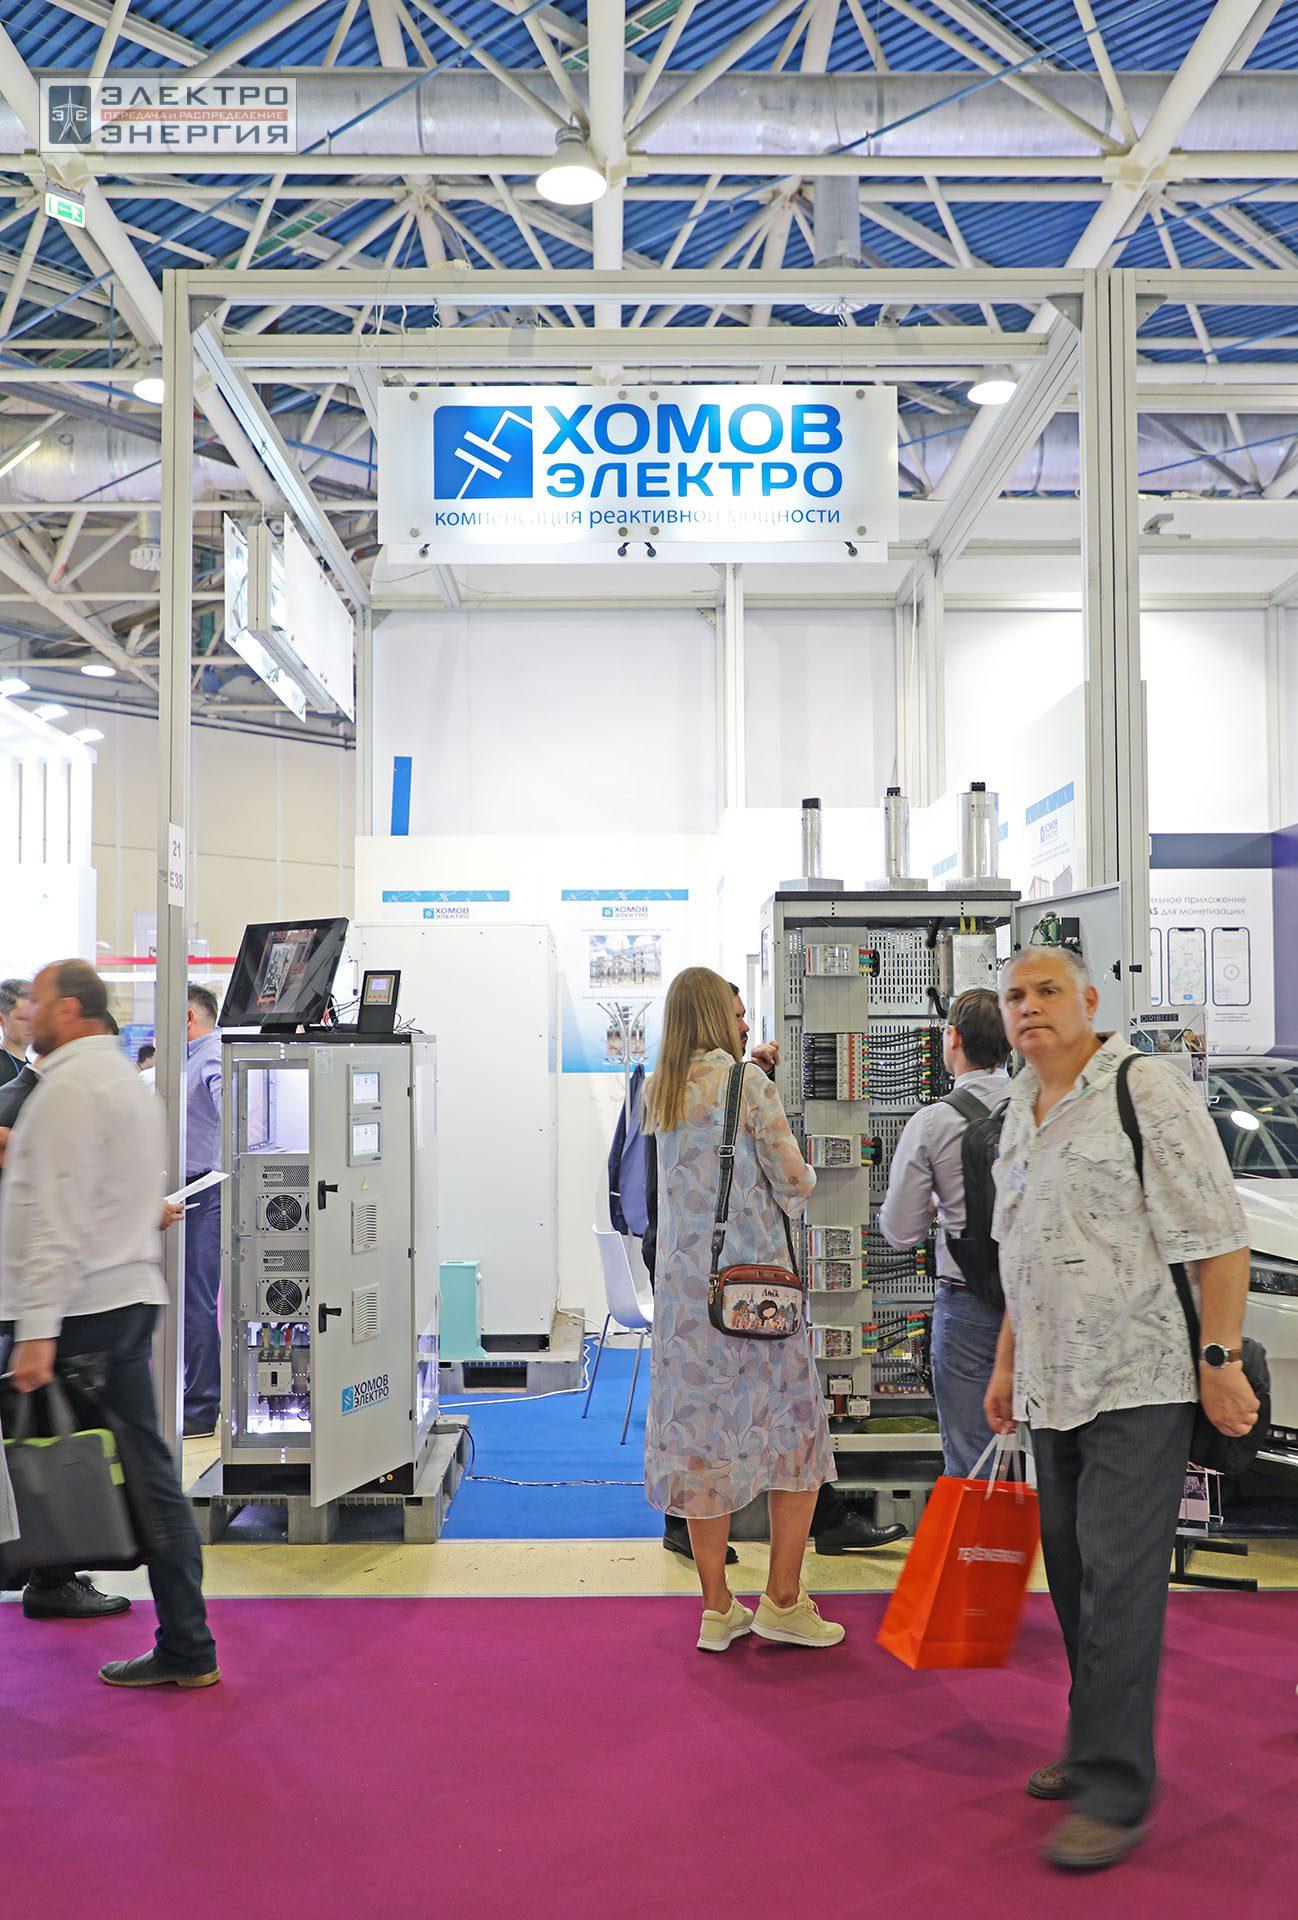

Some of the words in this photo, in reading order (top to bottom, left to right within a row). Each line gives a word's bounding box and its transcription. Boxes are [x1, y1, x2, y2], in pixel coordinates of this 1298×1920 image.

[542, 403, 844, 455] ХОМОВ
[546, 461, 844, 498] ЭЛЕКТРО
[434, 511, 582, 528] компенсация
[590, 508, 720, 528] реактивной
[728, 509, 840, 526] мощности
[172, 840, 181, 858] 21
[170, 871, 184, 890] E38
[1184, 896, 1246, 906] приложение
[1179, 908, 1245, 916] монетизации
[354, 1374, 389, 1397] ХОМОВ
[354, 1386, 389, 1408] ЭЛЕКТРО
